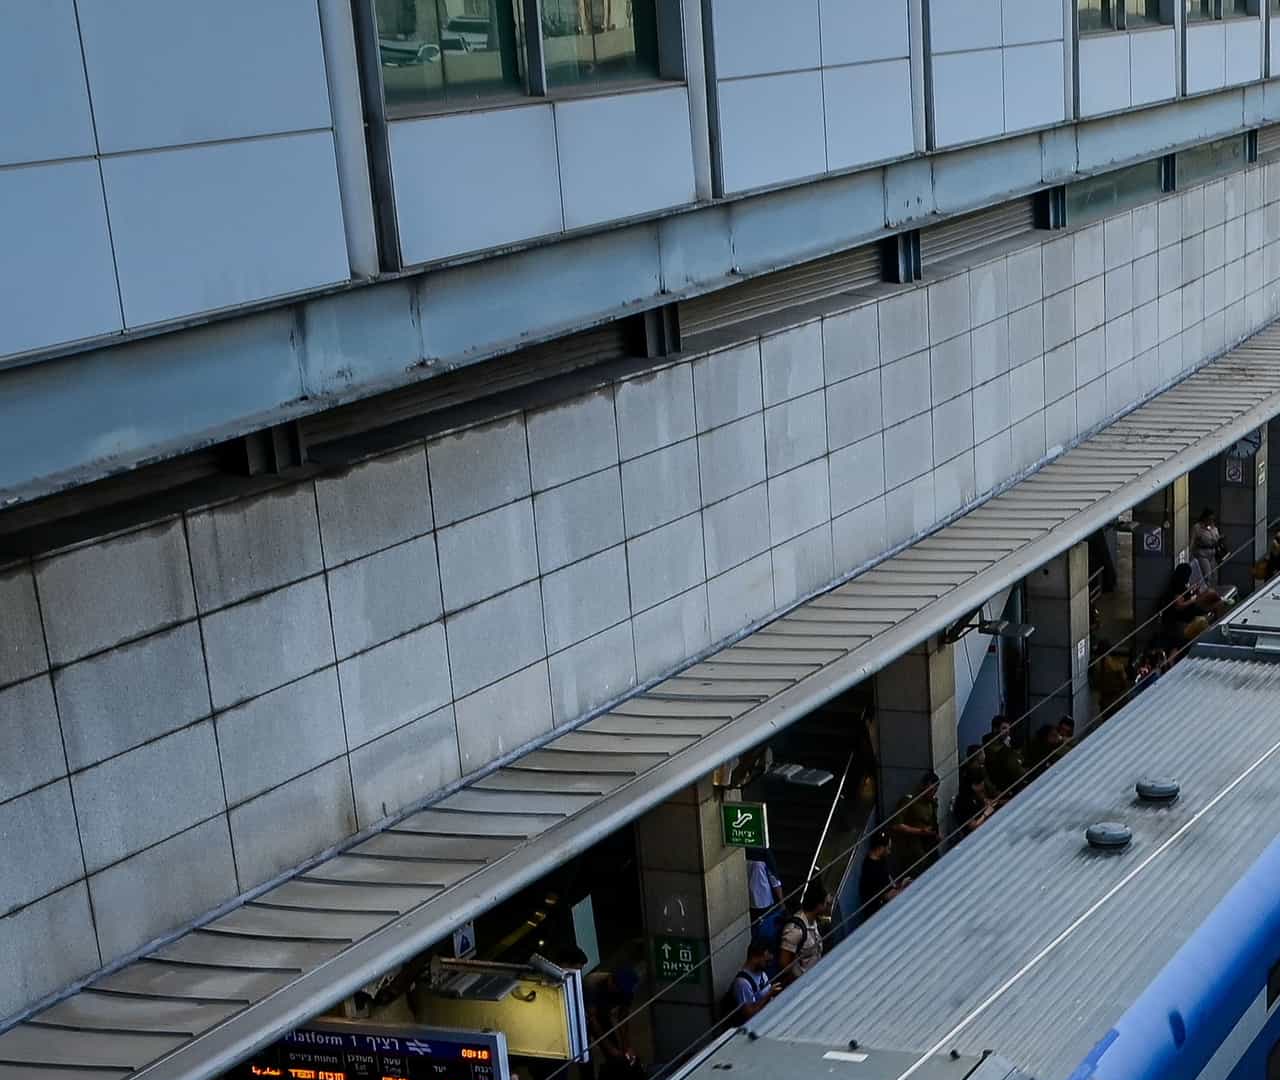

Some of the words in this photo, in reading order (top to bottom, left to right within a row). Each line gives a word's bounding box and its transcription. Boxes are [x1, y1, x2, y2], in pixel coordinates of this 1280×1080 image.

[350, 1035, 357, 1047] 1
[366, 1036, 399, 1052] רציף
[383, 1057, 401, 1066] שעה
